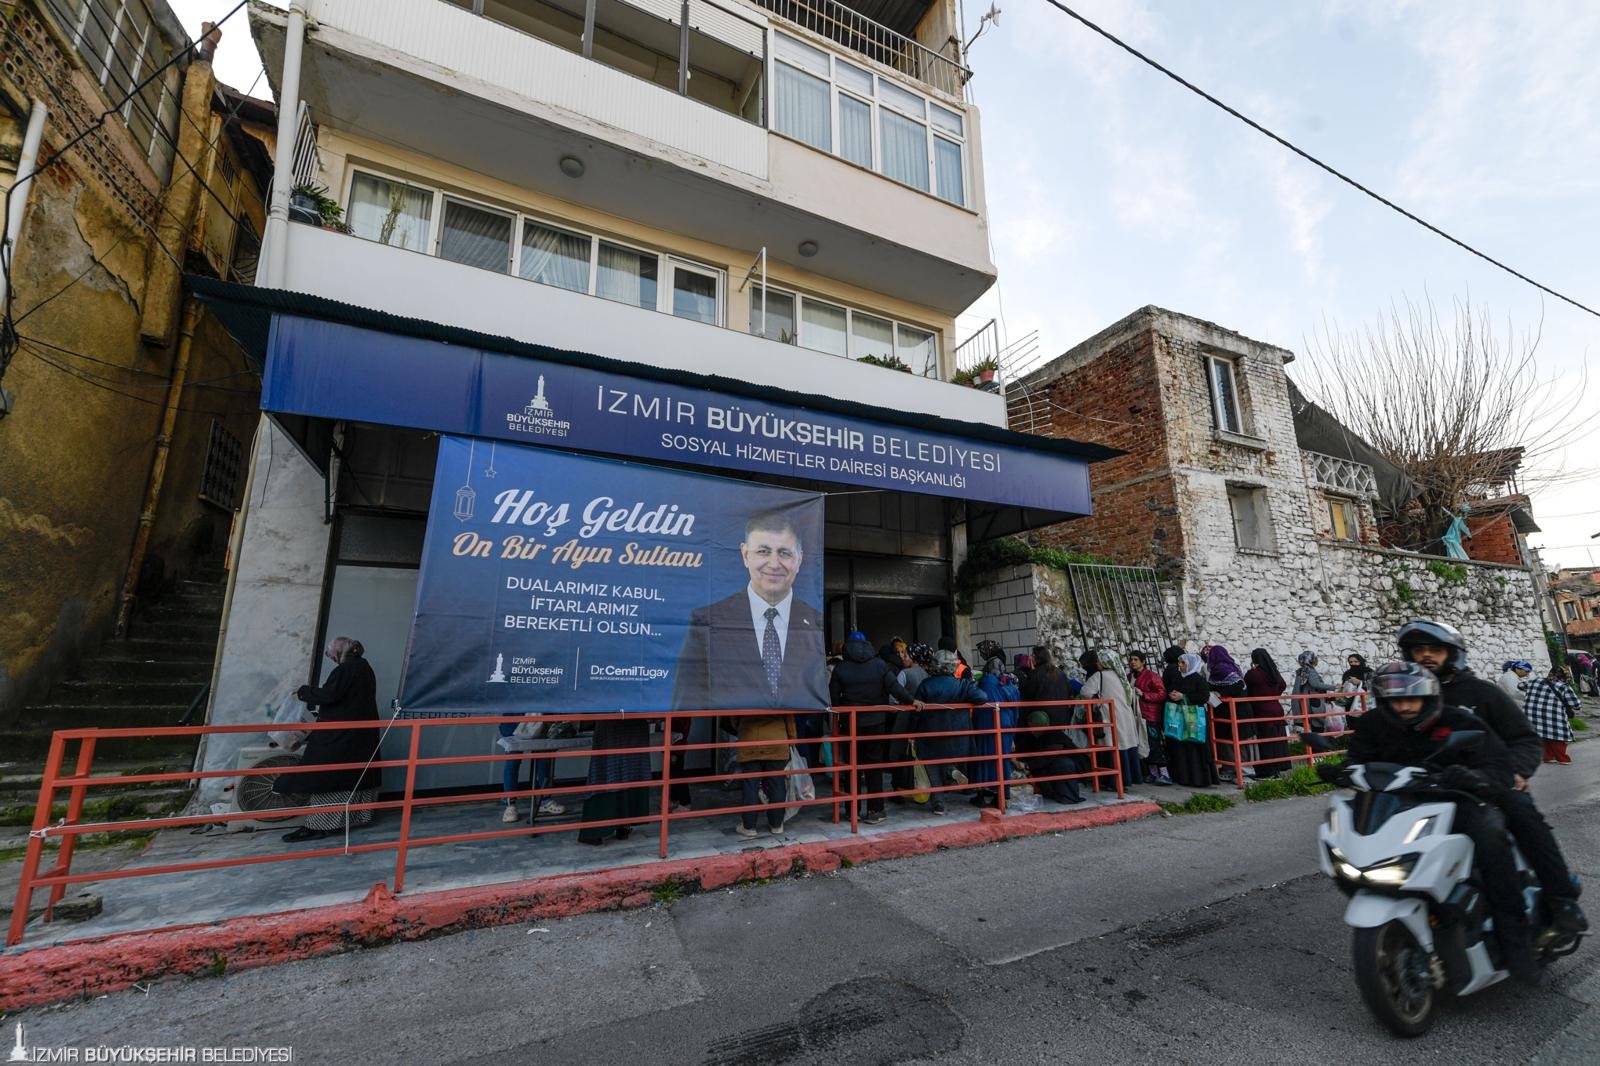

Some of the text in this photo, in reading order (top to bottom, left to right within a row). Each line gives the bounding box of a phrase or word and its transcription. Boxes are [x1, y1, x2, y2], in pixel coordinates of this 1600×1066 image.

[506, 413, 570, 430] BÜYÜKŞEHİR
[509, 422, 567, 437] BELEDİYESİ
[597, 385, 1001, 473] İZMİR BÜYÜKŞEHİR BELEDİYESİ
[661, 433, 966, 489] SOSYAL HİZMETLER DAİRESİ BAŞKANLIĞI
[490, 488, 696, 538] Hoş Geldin
[452, 531, 703, 569] On Bir Ayın Sultanı
[506, 576, 665, 602] DUALARIMIZ KABUL,
[531, 595, 639, 617] İFTARLARIMIZ
[504, 615, 662, 637] BEREKETLİ OLSUN...
[511, 665, 564, 676] BÜYÜKŞEHİR
[512, 655, 536, 665] İZMİR
[510, 676, 559, 684] BELEDİYESİ
